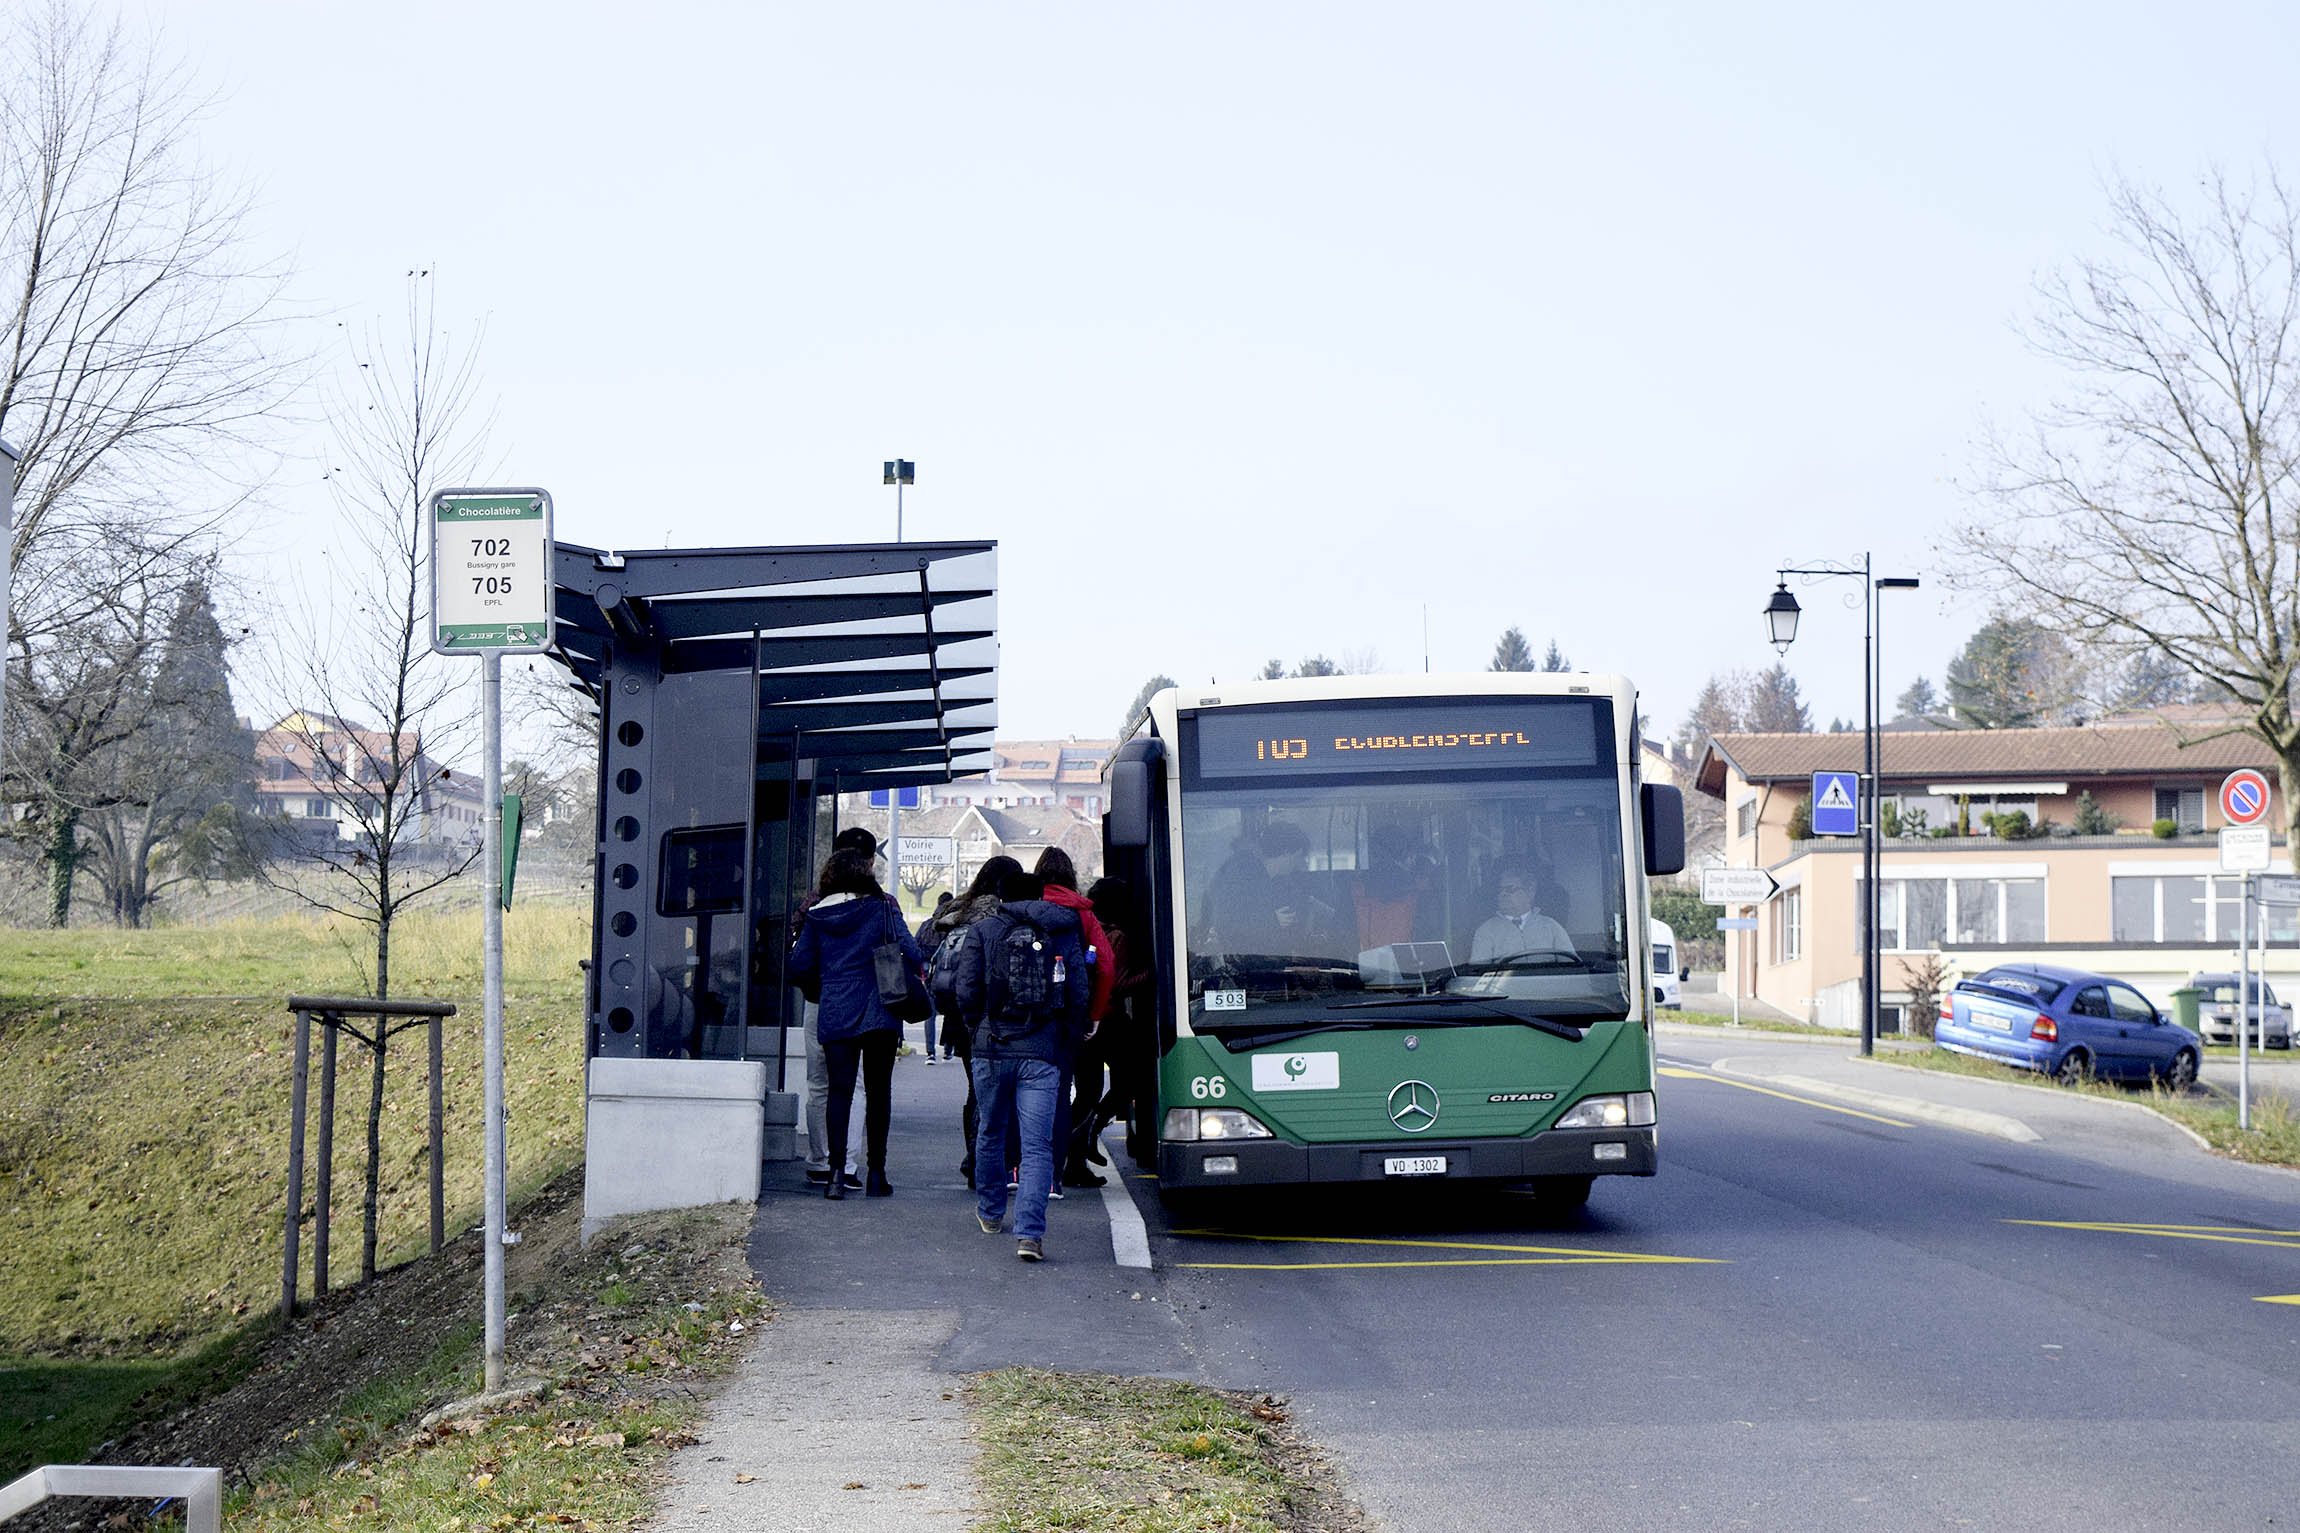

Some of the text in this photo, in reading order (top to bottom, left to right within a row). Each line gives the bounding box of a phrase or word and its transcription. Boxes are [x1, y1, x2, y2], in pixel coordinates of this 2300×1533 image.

[458, 506, 521, 516] Chocolatière
[471, 539, 511, 556] 702
[472, 577, 512, 594] 705
[904, 840, 934, 849] Voirie
[1215, 993, 1244, 1005] 503
[1191, 1075, 1227, 1099] 66
[1489, 1092, 1555, 1102] CITARO
[1392, 1159, 1439, 1172] VD 1302
